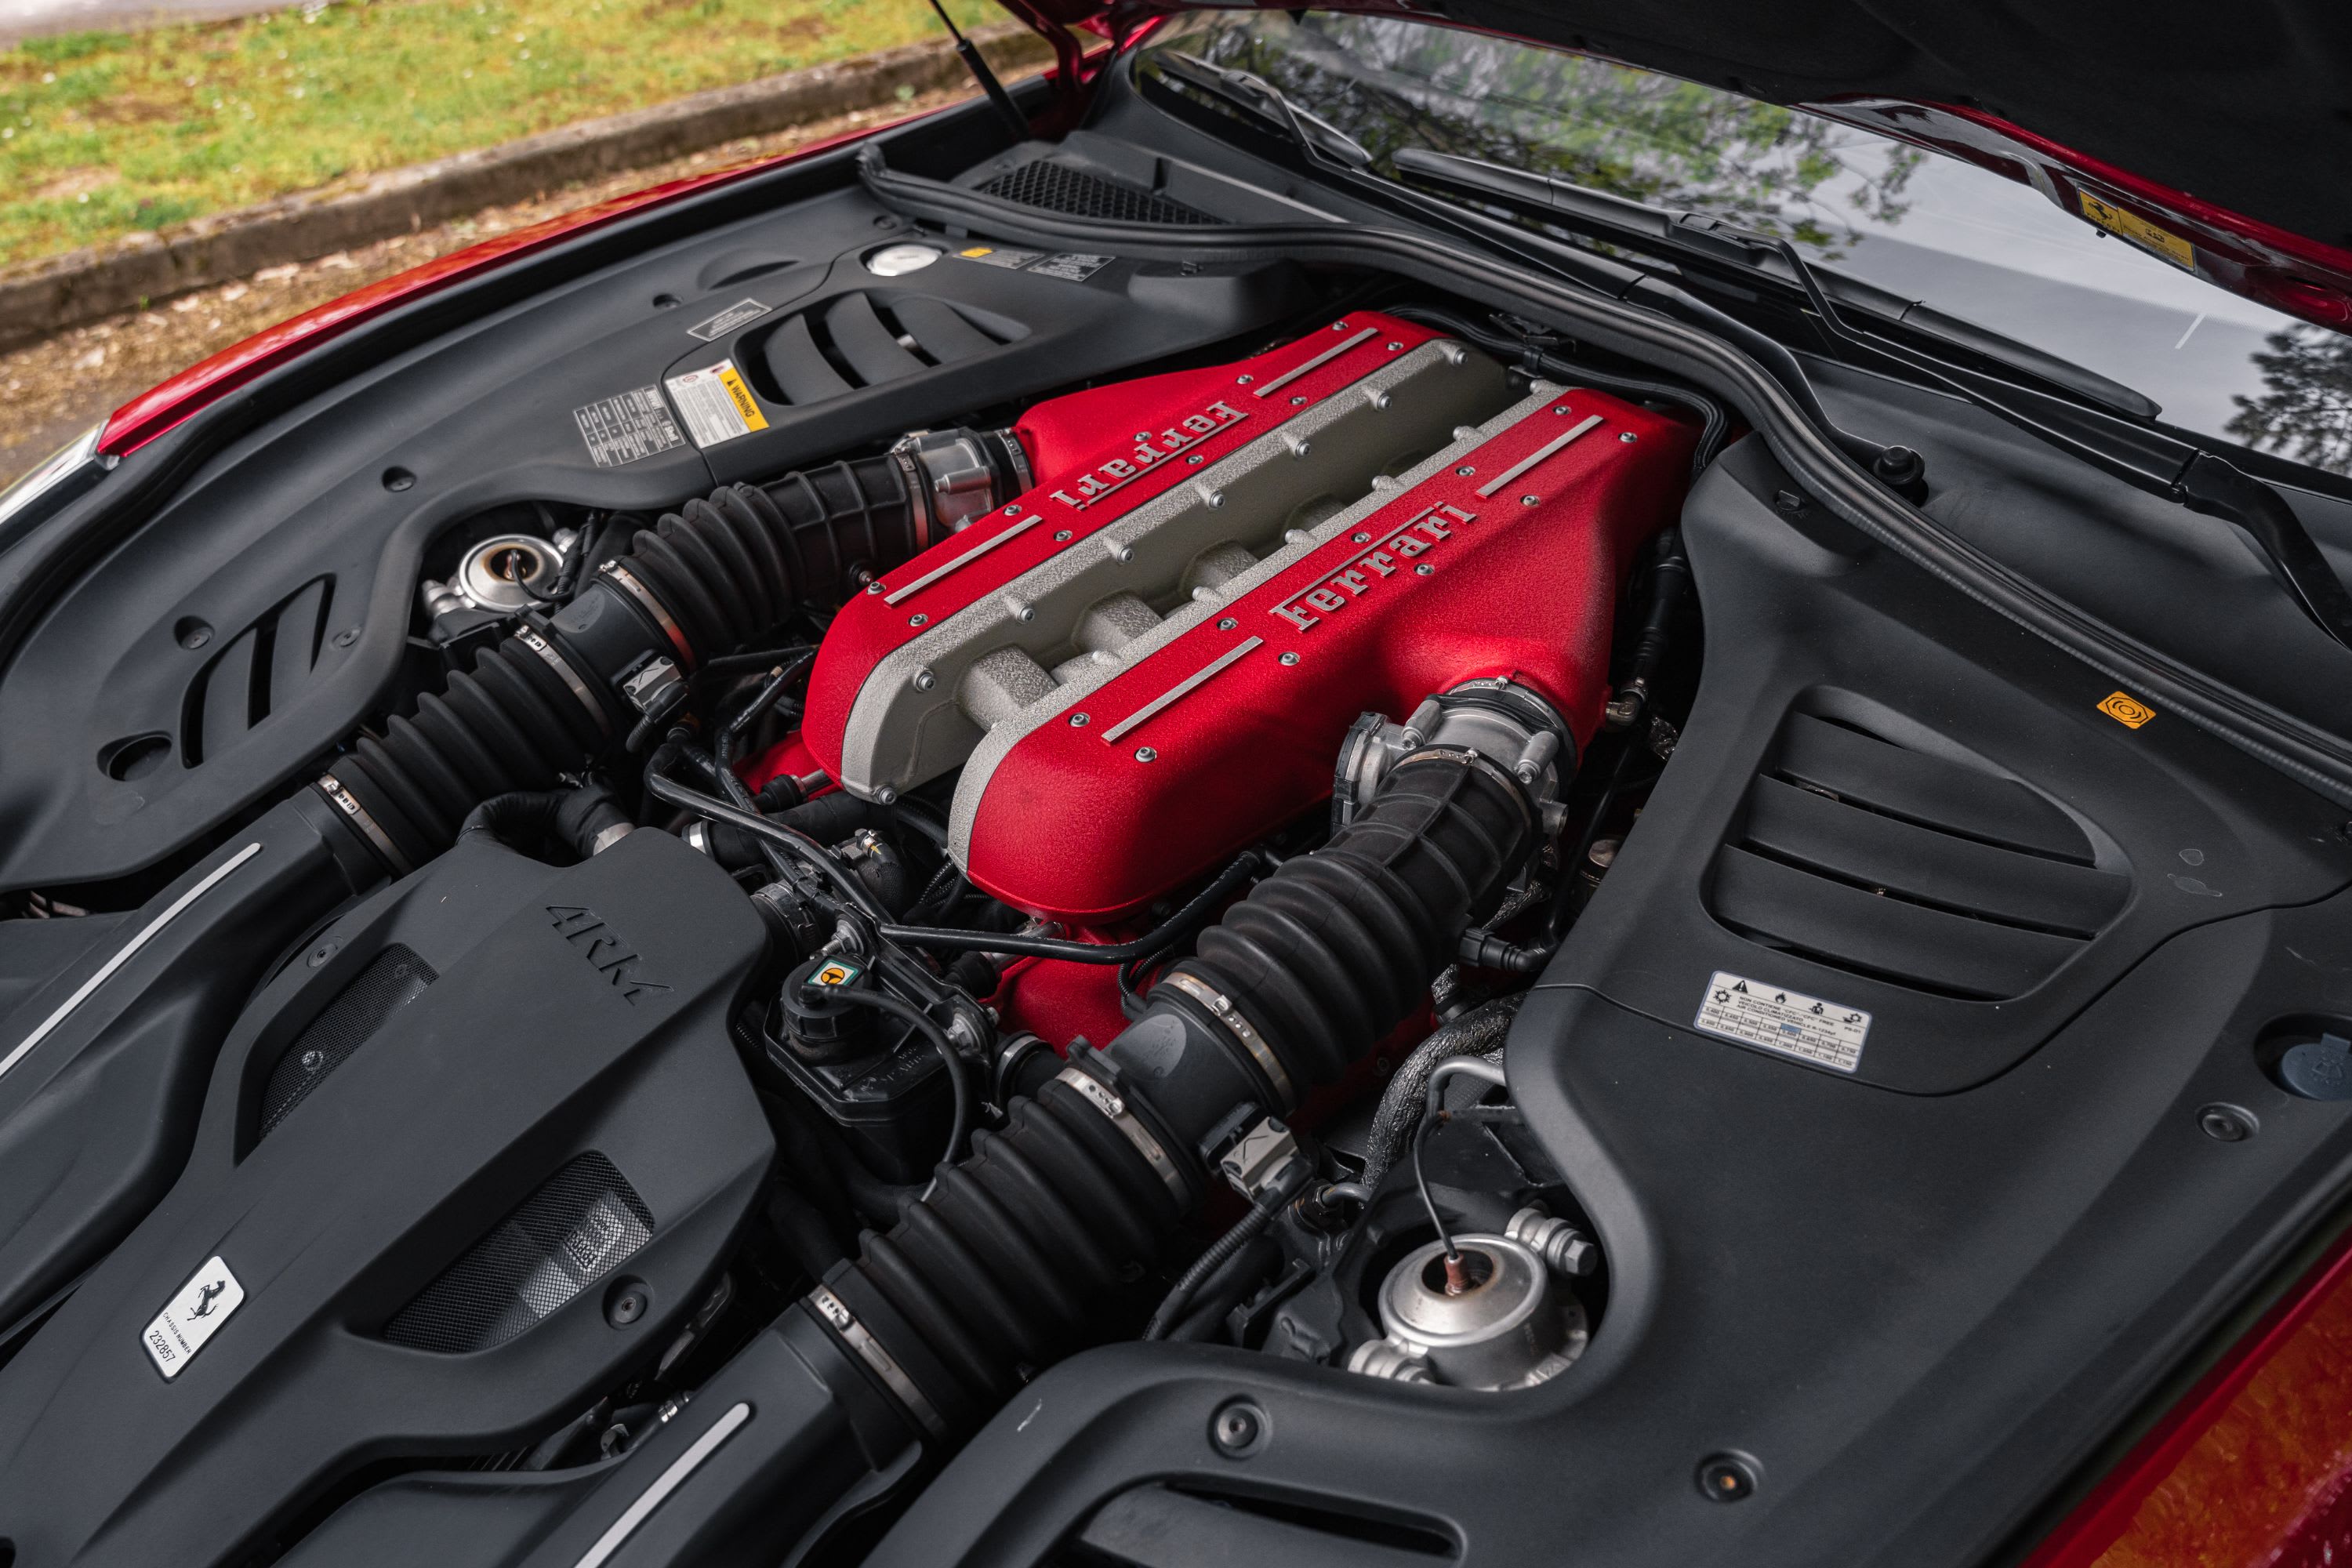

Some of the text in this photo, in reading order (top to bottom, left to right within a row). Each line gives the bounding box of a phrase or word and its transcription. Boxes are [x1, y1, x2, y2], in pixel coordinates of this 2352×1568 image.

[731, 384, 755, 417] WARNING
[664, 426, 679, 441] Shell
[1050, 401, 1250, 510] Ferrari
[1270, 500, 1478, 632] Ferrari
[1738, 1000, 1803, 1022] VEICOLO CLIMATIZZATO
[1747, 1007, 1786, 1021] CONDITIONED
[1787, 1018, 1811, 1029] VEHICLE
[1753, 999, 1781, 1010] CONTIENE
[150, 1330, 176, 1363] 232857
[163, 1312, 191, 1354] CHASSIS NUMBER
